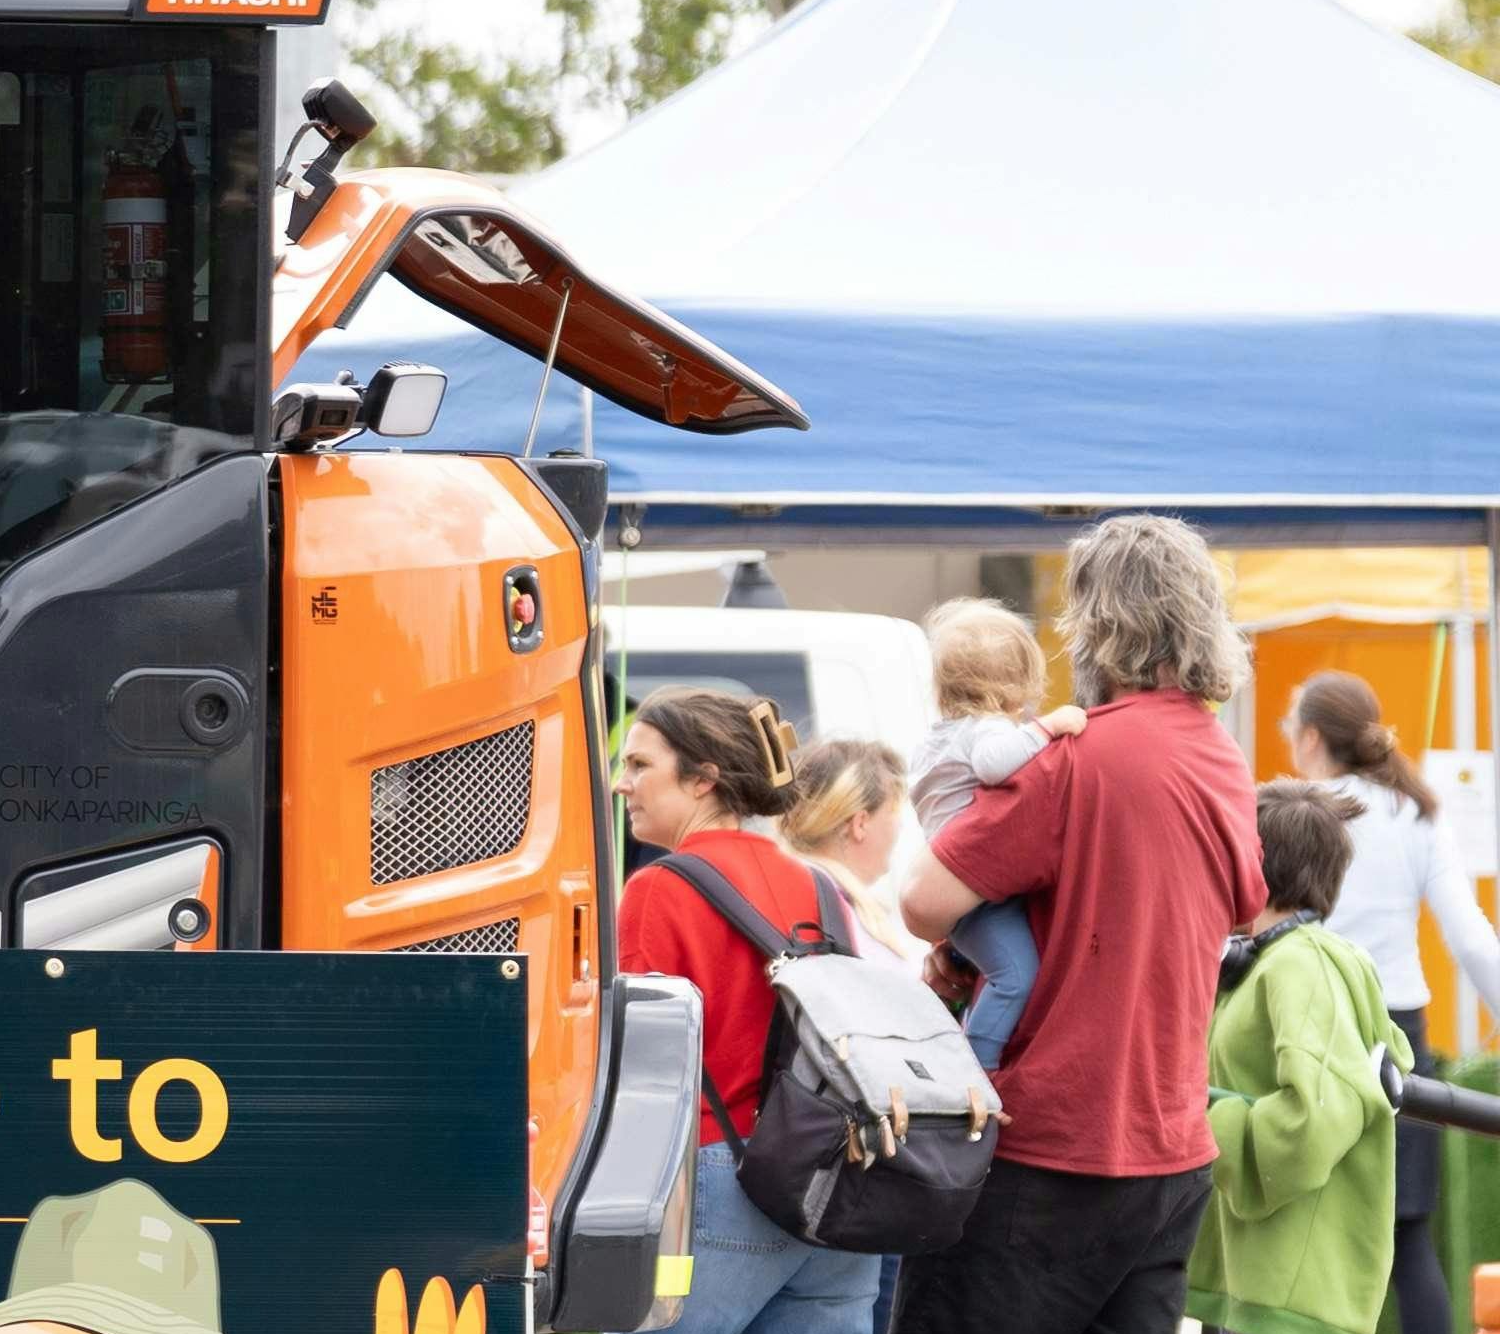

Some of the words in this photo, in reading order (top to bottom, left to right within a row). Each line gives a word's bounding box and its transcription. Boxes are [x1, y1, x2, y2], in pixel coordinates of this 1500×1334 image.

[0, 765, 61, 789] CITY
[70, 766, 110, 789] OF
[0, 798, 205, 825] ONKAPARINGA
[51, 1027, 230, 1164] to
